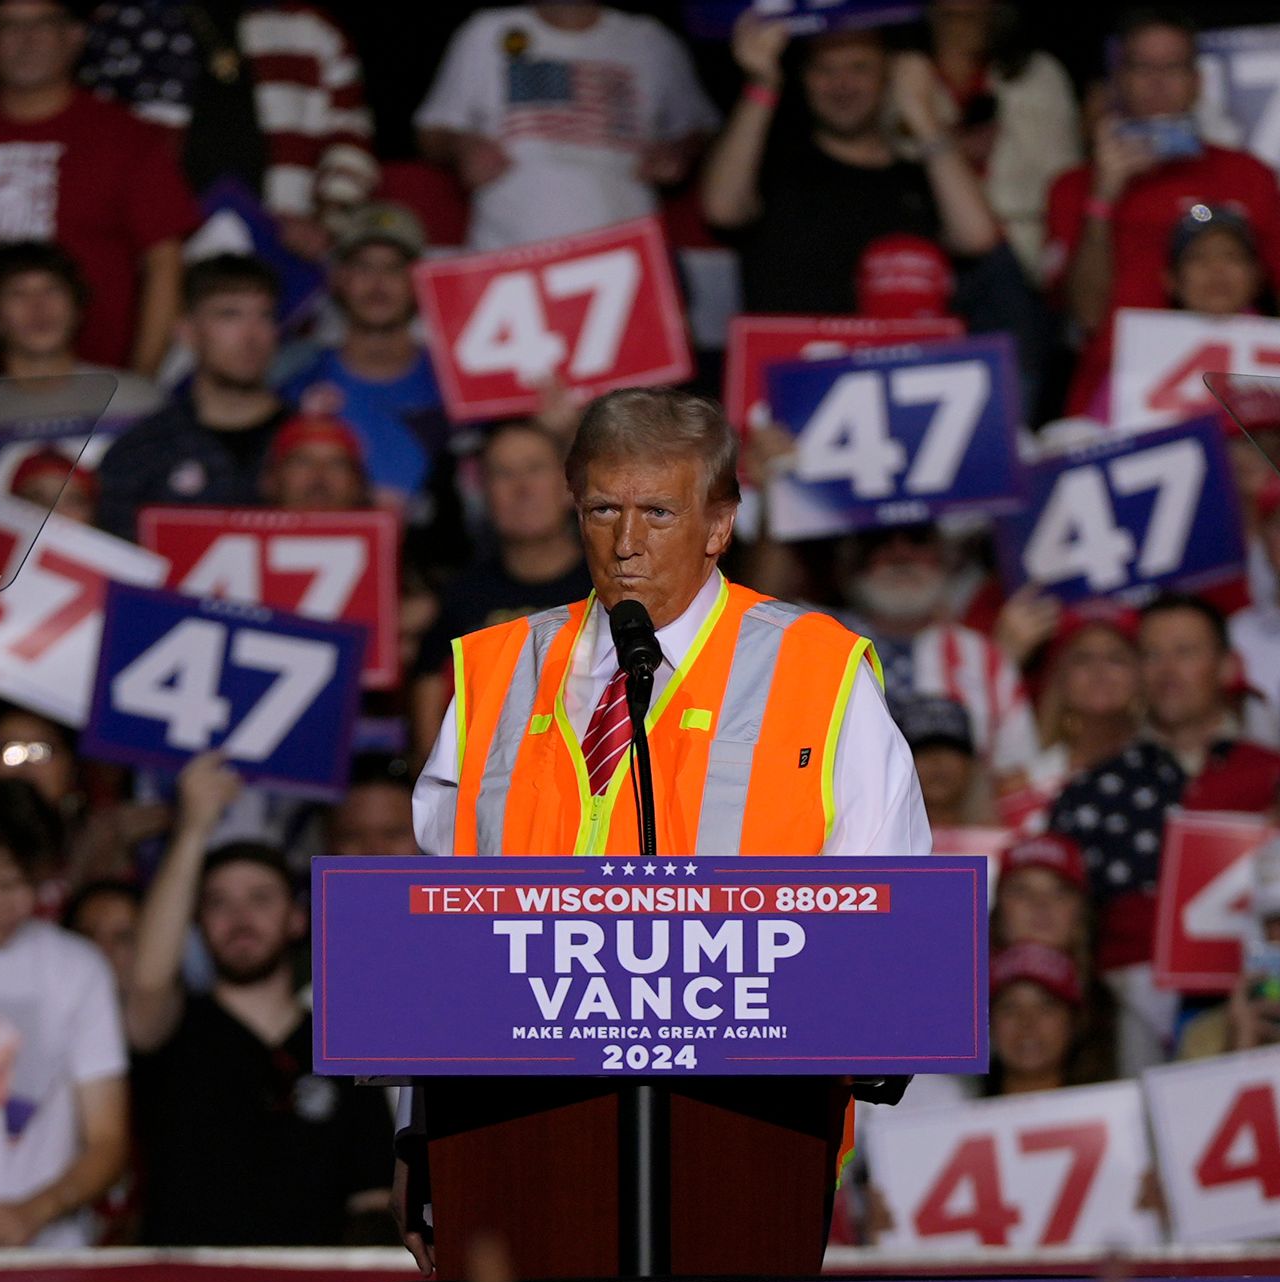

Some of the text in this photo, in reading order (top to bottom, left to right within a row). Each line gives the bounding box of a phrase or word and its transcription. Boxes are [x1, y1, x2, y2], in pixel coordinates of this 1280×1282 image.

[456, 250, 639, 381] 47
[794, 361, 990, 497] 47
[1023, 437, 1208, 588] 47
[178, 532, 370, 622] 47
[111, 616, 340, 763] 47
[422, 886, 878, 912] TEXT WISCONSIN TO 88022
[493, 920, 807, 974] TRUMP
[513, 1026, 788, 1040] MAKE AMERICA GREAT AGAIN!
[528, 976, 770, 1021] VANCE
[602, 1044, 698, 1070] 2024
[913, 1117, 1107, 1246] 47
